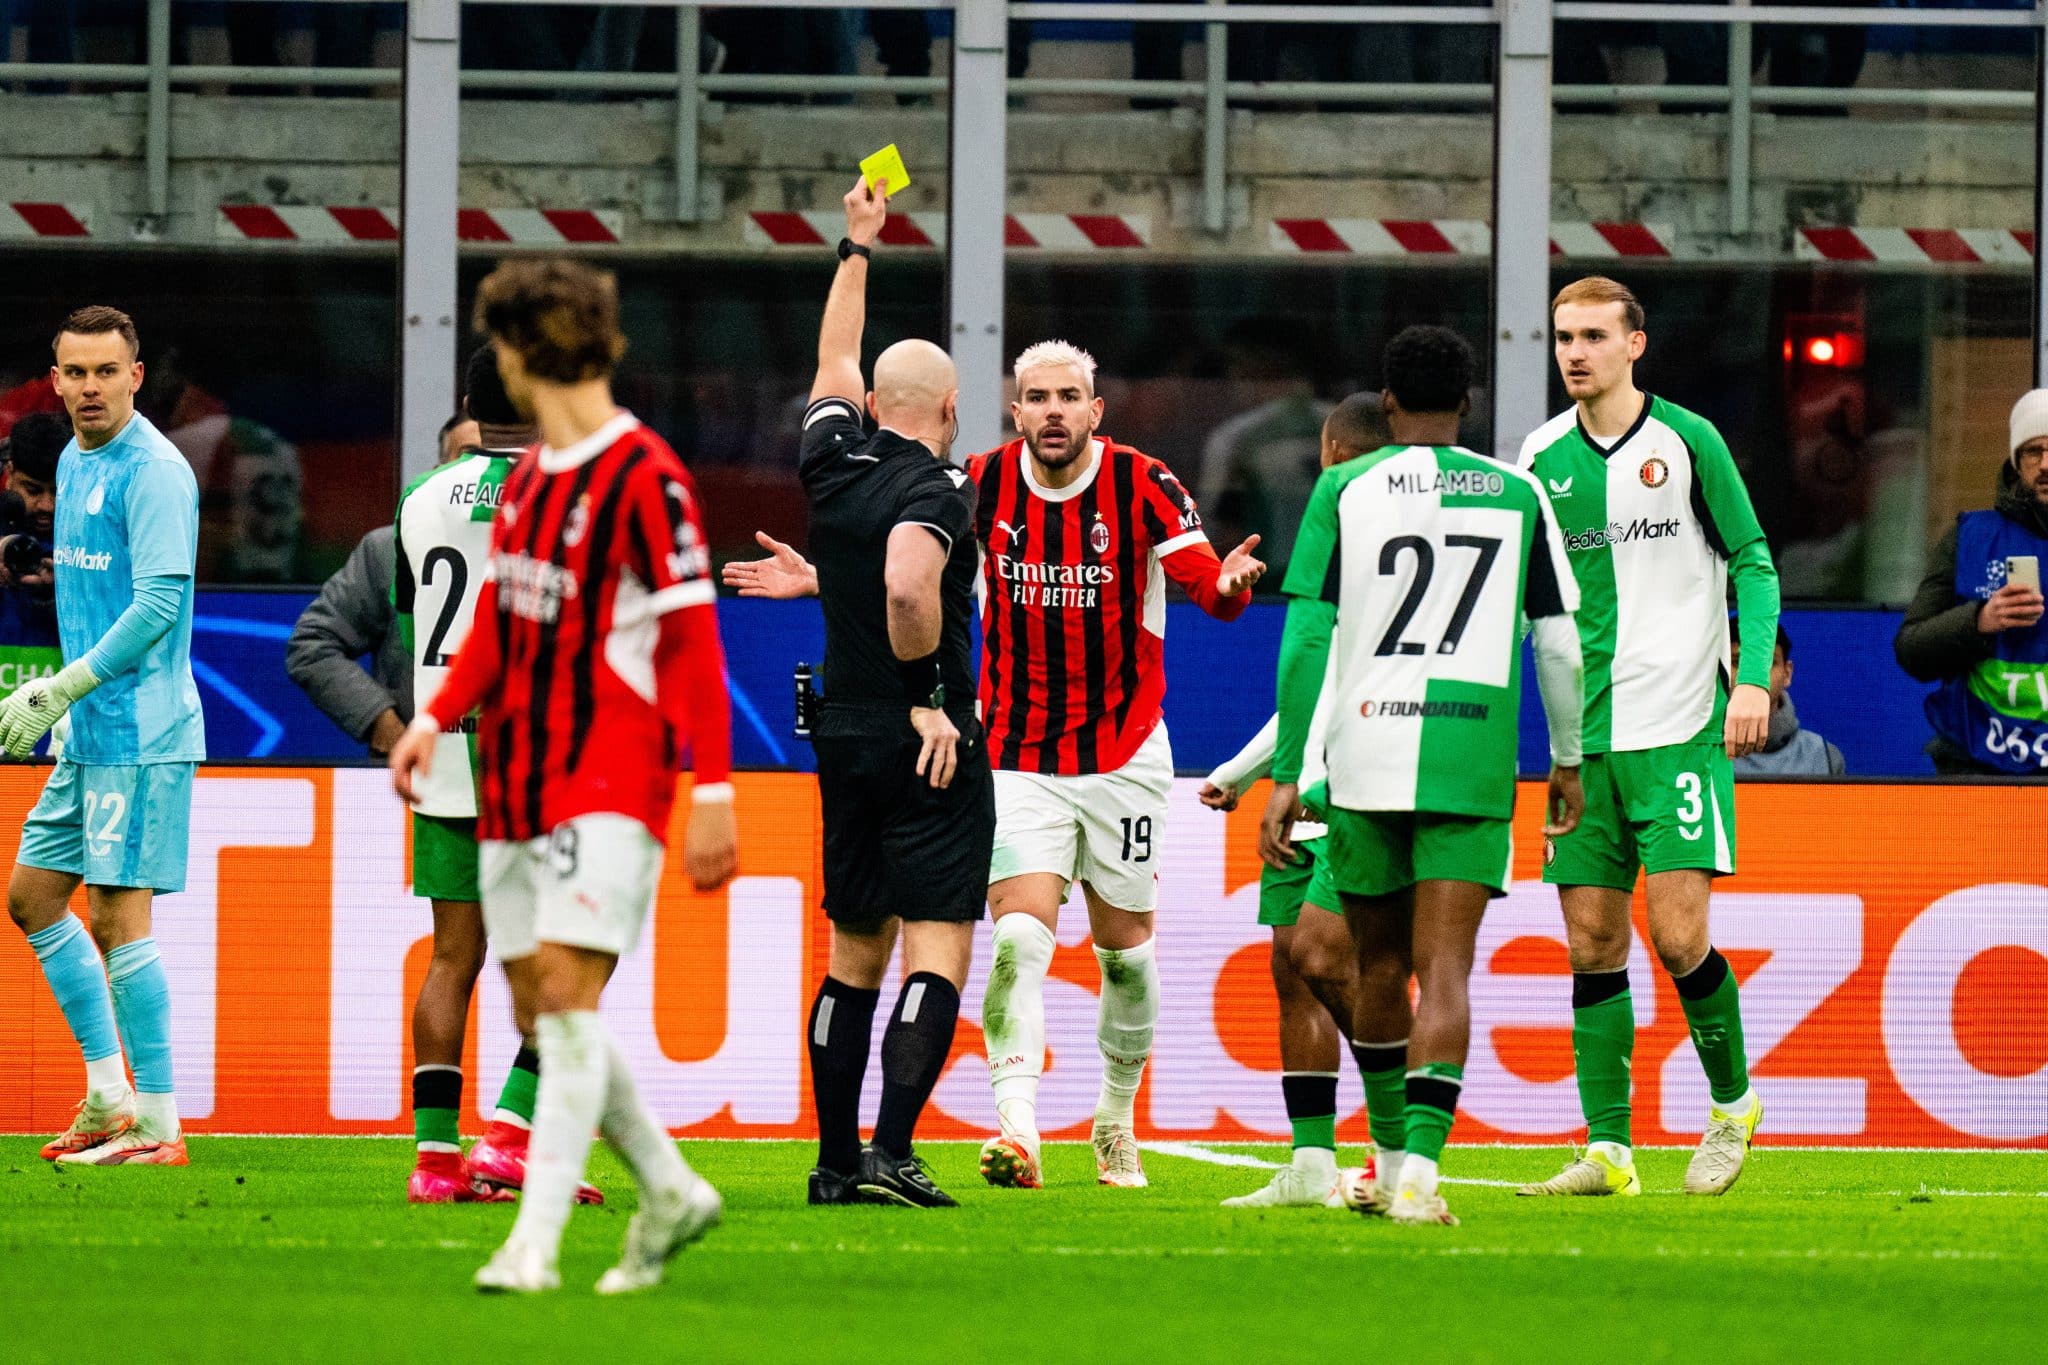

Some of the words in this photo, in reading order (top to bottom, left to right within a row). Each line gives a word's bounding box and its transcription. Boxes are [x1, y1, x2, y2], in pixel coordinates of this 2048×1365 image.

[1387, 470, 1504, 497] MILAMBO
[1623, 517, 1680, 543] Markt
[996, 553, 1114, 585] Emirates
[1013, 584, 1036, 606] FLY
[1041, 586, 1096, 609] BETTER
[1373, 534, 1503, 657] 27
[1379, 700, 1488, 720] FOUNDATION
[1676, 771, 1703, 823] 3
[84, 790, 125, 841] 22
[1119, 815, 1151, 862] 19
